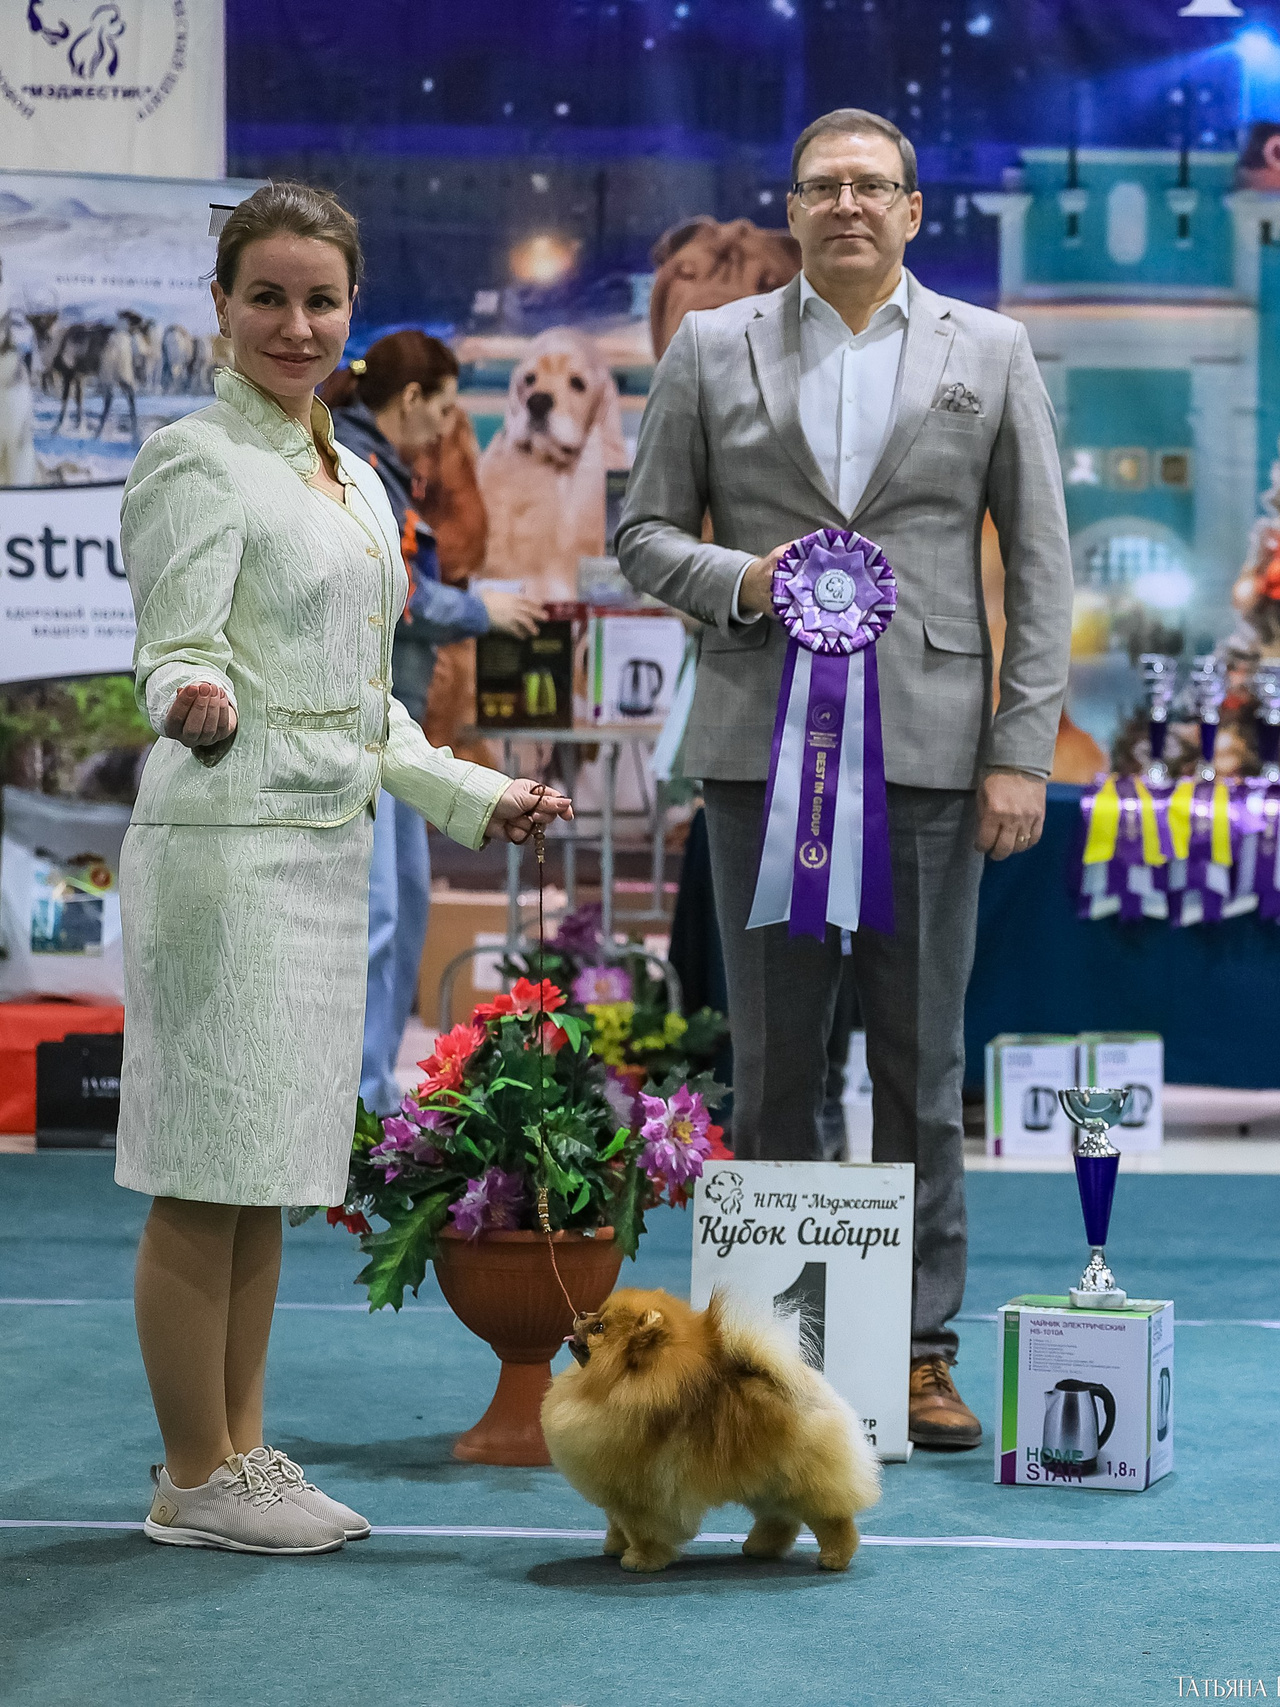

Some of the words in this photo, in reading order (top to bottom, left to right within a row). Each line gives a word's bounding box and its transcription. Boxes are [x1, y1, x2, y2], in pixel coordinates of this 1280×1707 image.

[5, 526, 127, 579] stru
[815, 751, 827, 780] BEST
[814, 781, 825, 794] IN
[811, 796, 823, 836] GROUP
[809, 847, 818, 861] 1
[754, 1193, 798, 1212] НГКЦ
[699, 1215, 786, 1258] Кубок
[798, 1216, 901, 1260] Сибири
[773, 1262, 827, 1375] 1
[1030, 1319, 1060, 1328] ЧАЙНИК
[1062, 1321, 1126, 1332] ЭЛЕКТРИЧЕСКИЙ
[1026, 1446, 1084, 1464] HOME
[1026, 1462, 1082, 1483] STAR
